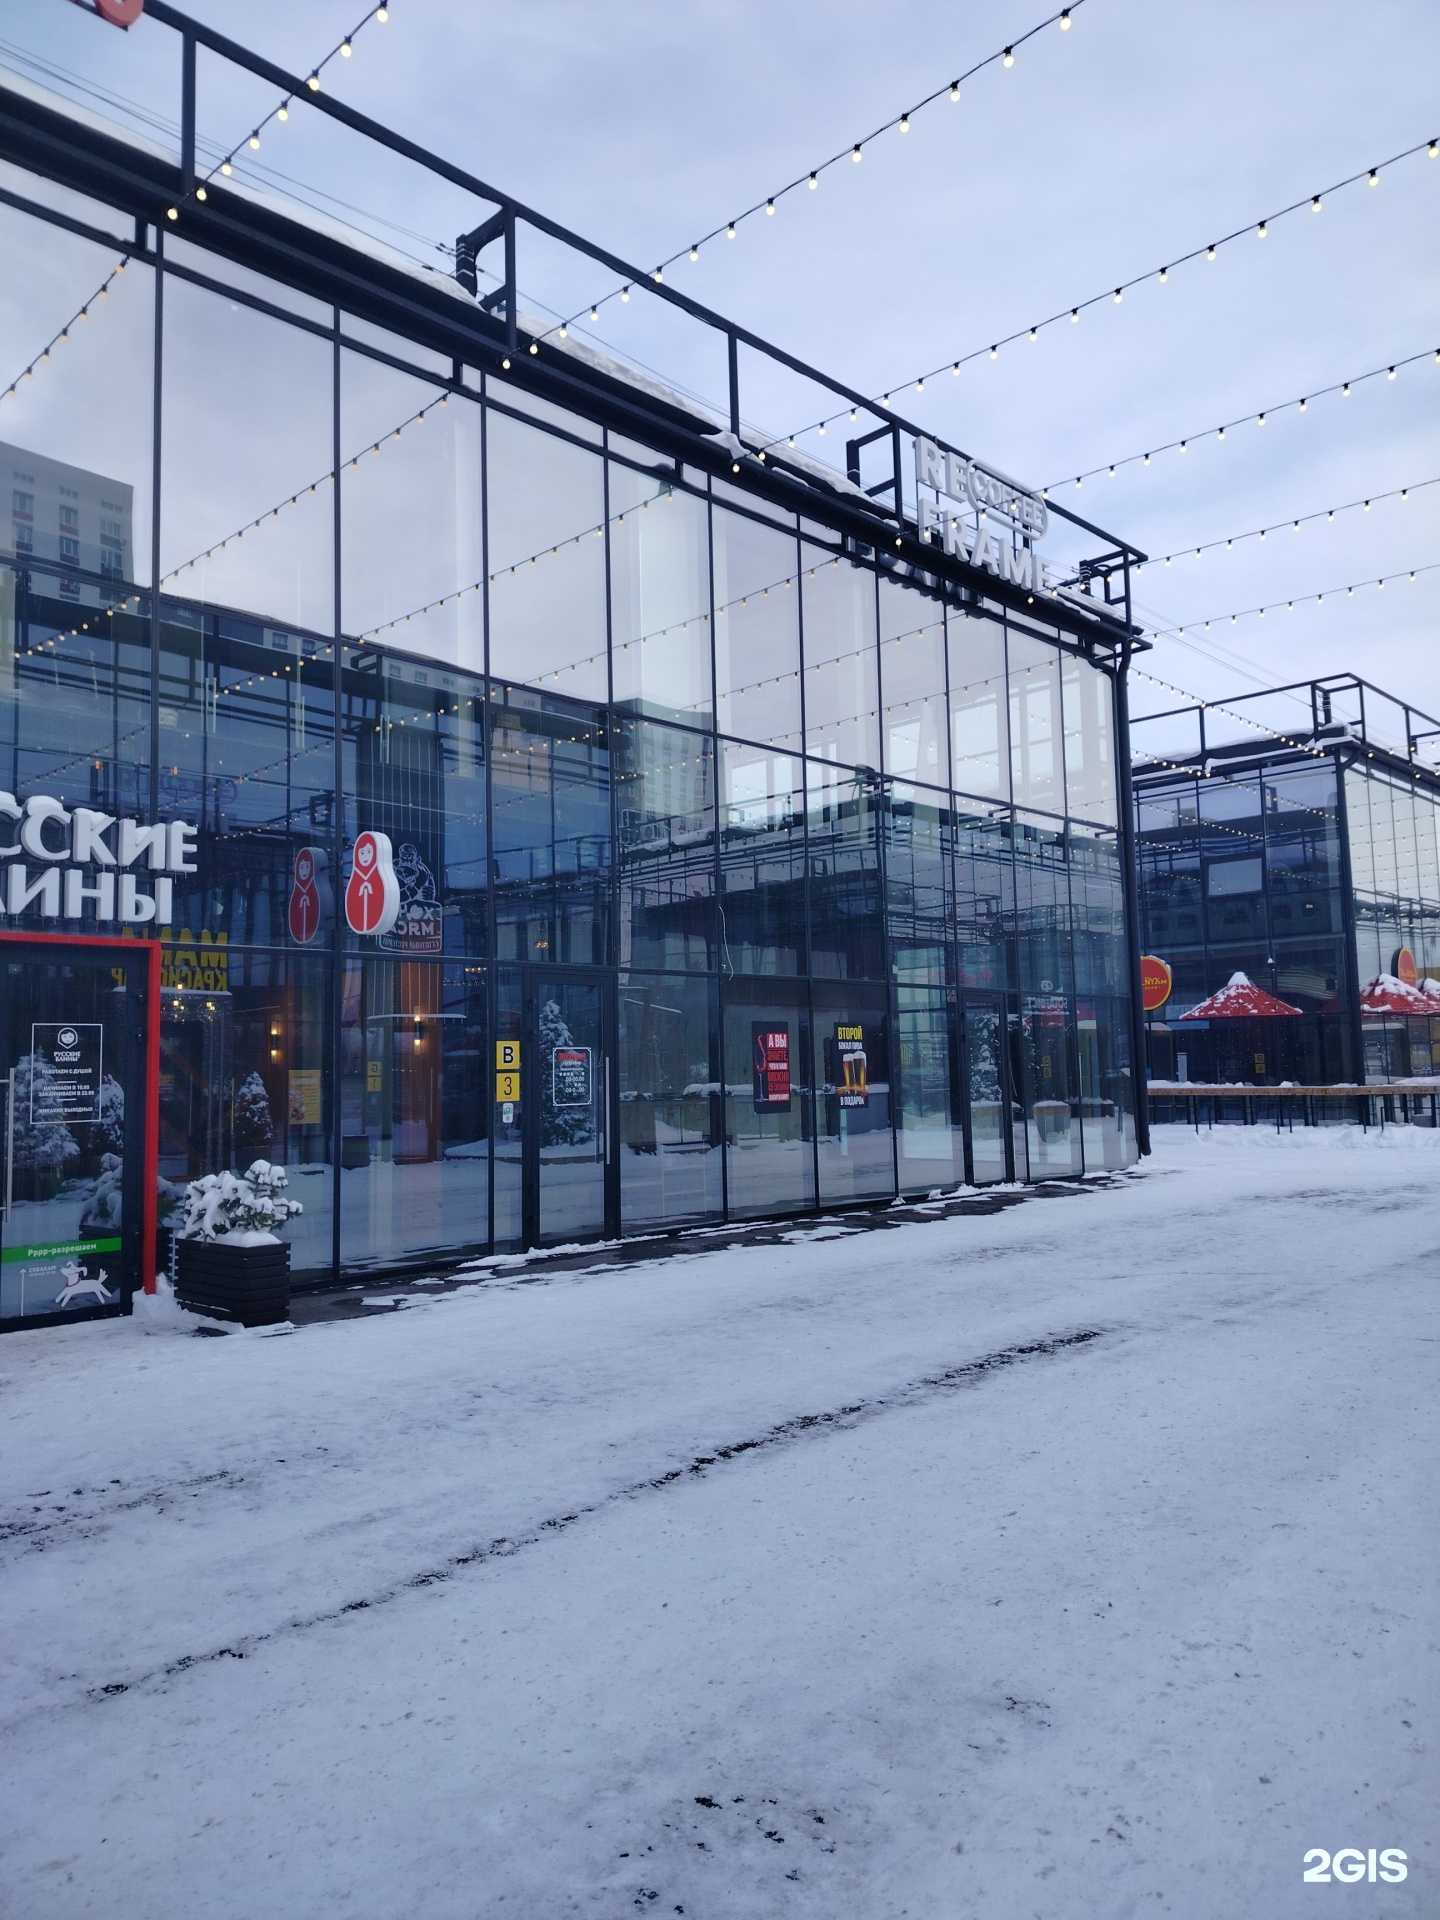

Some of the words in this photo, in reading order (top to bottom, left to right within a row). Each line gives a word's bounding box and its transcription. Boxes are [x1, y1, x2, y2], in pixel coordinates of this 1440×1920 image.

[918, 498, 1050, 594] FRAME
[0, 863, 173, 924] ИНЫ
[775, 1034, 787, 1048] ВЫ
[838, 1025, 863, 1040] ВТОРОЙ
[504, 1076, 512, 1096] 3
